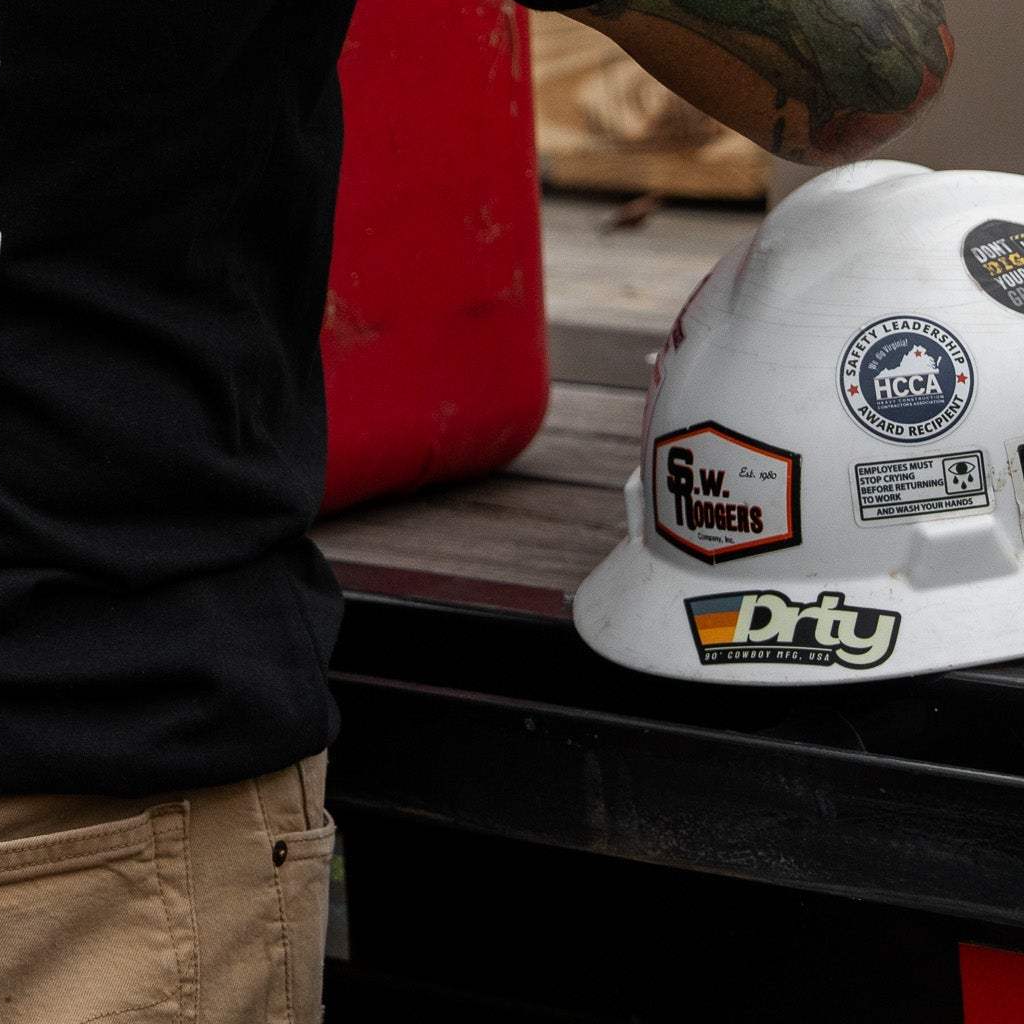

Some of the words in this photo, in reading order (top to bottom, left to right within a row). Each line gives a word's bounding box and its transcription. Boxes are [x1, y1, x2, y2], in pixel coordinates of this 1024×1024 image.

[846, 328, 878, 376] SAFETY
[882, 320, 965, 365] LEADERSHIP
[873, 372, 943, 400] HCCA
[857, 405, 905, 436] AWARD
[908, 394, 964, 437] RECIPIENT
[666, 445, 730, 499] S.W.
[738, 466, 756, 479] Est.
[758, 470, 778, 482] 1980
[858, 463, 908, 475] EMPLOYEES
[909, 460, 934, 470] MUST
[860, 475, 882, 486] STOP
[883, 471, 916, 483] CRYING
[861, 483, 894, 495] BEFORE
[896, 479, 944, 491] RETURNING
[674, 476, 764, 535] RODGERS
[862, 495, 874, 504] TO
[875, 493, 902, 503] WORK
[876, 507, 895, 516] AND
[895, 504, 920, 514] WASH
[920, 501, 944, 511] YOUR
[944, 497, 974, 508] HANDS
[727, 650, 771, 659] COWBOY
[809, 652, 830, 662] USA
